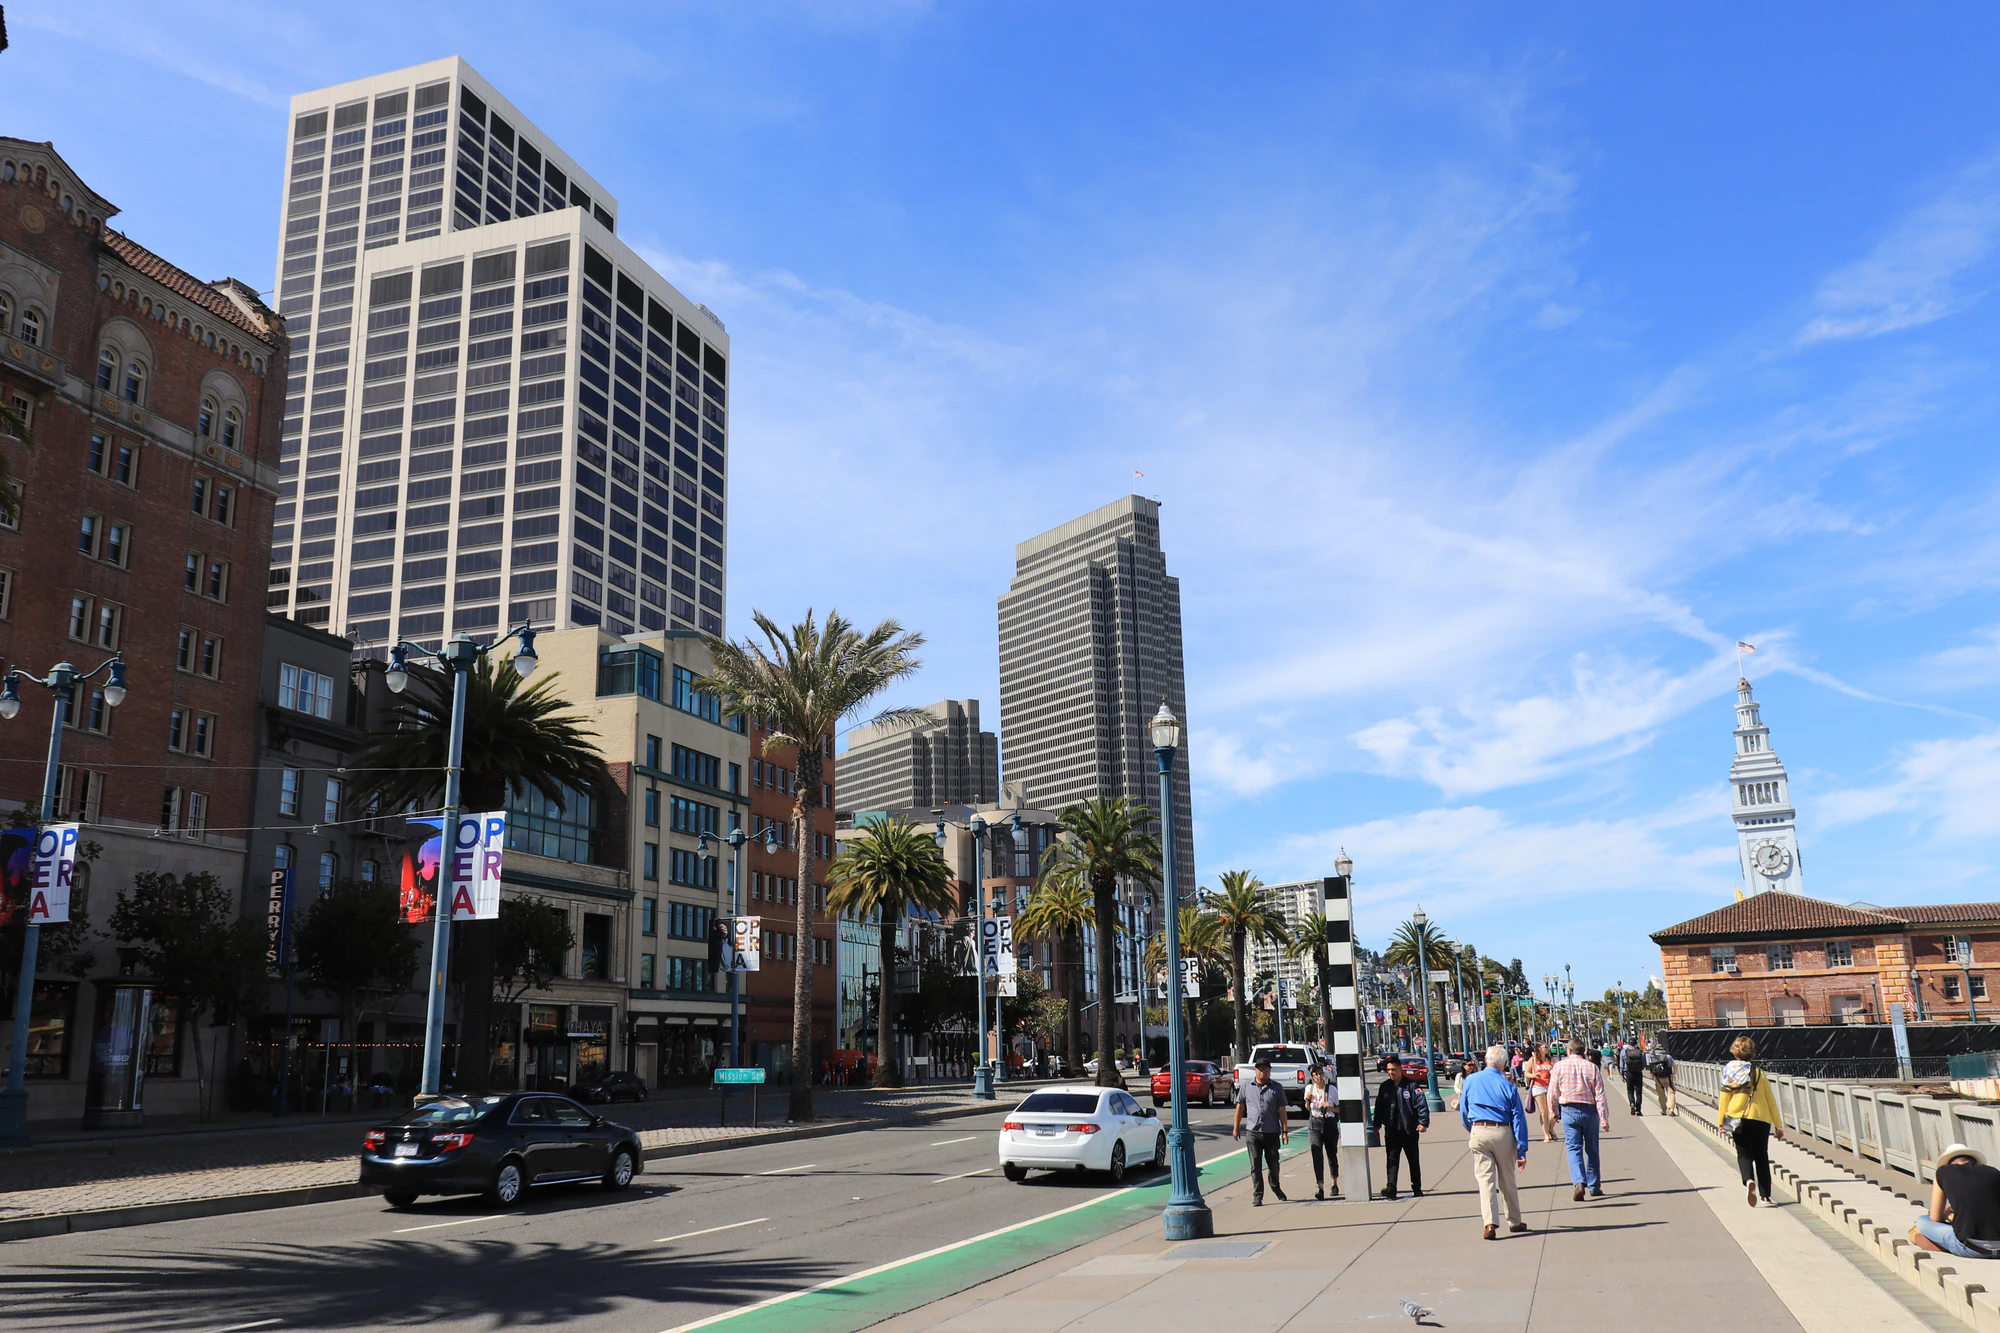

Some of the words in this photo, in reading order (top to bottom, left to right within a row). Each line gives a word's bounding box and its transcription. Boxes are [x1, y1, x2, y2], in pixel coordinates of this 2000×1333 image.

[265, 871, 284, 963] PERRY'S
[567, 1020, 603, 1033] CHAYA
[719, 1071, 748, 1081] Mission
